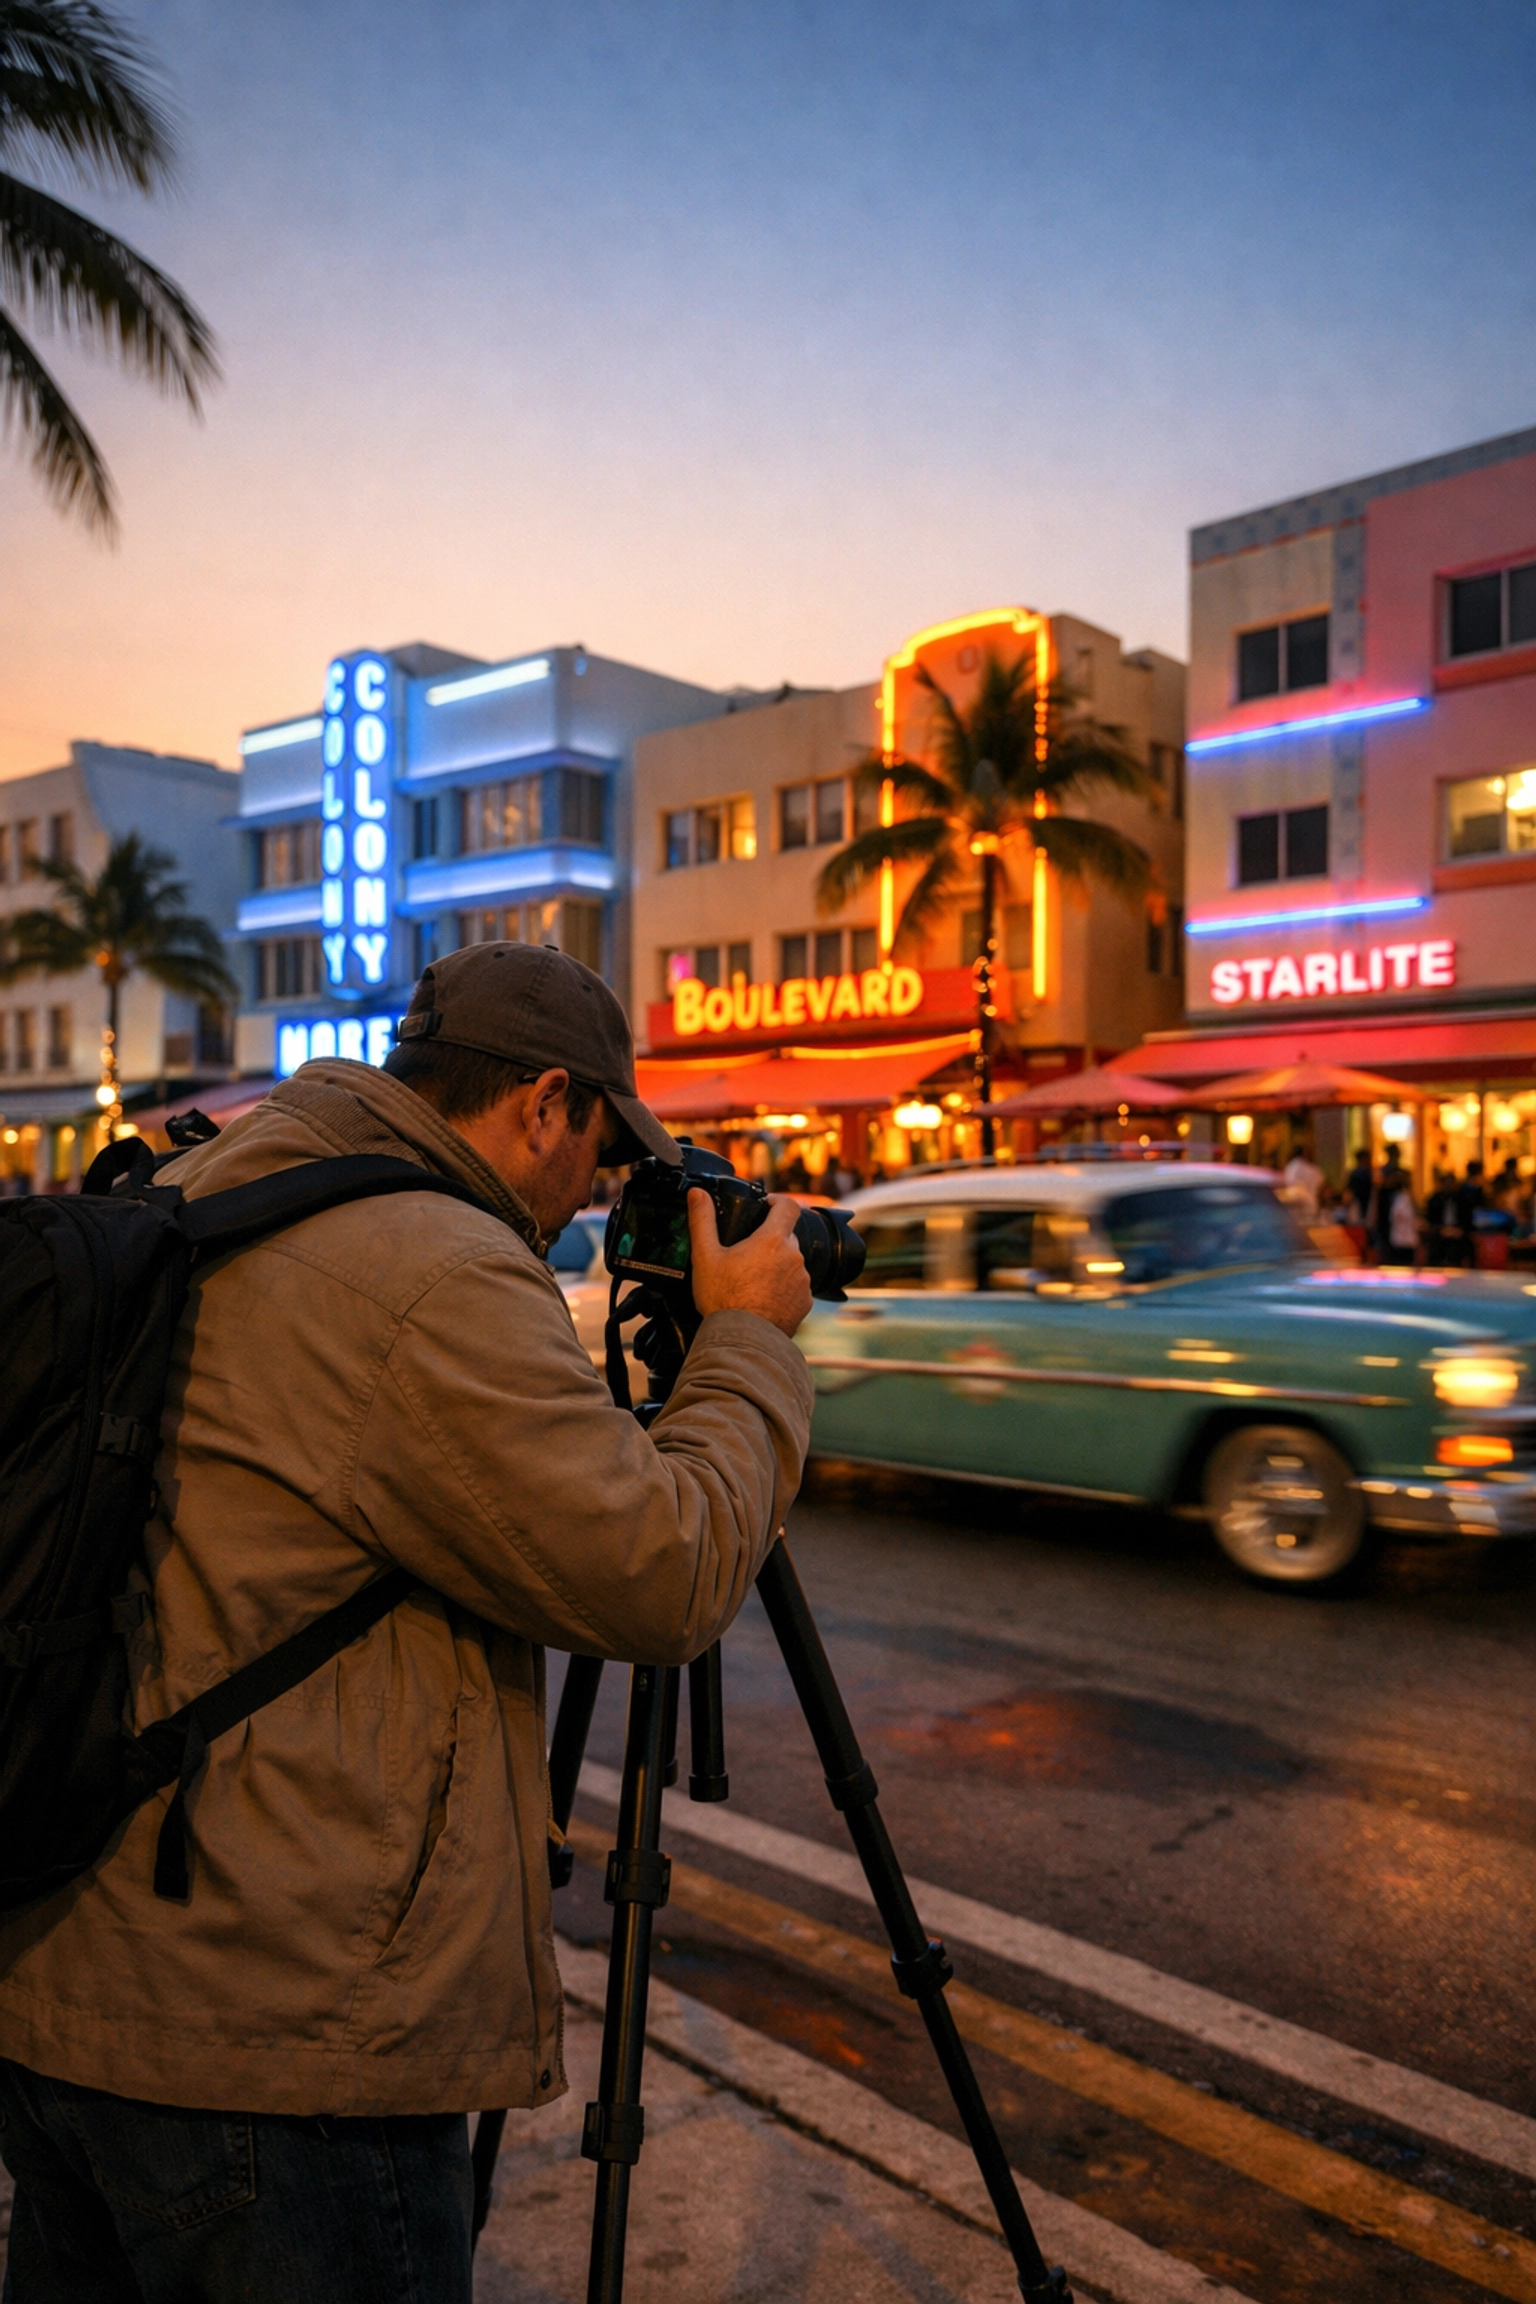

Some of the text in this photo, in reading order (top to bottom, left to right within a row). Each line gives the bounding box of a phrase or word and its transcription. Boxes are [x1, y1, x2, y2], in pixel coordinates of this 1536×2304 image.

[323, 660, 346, 983] COLONY
[352, 660, 387, 983] COLONY
[673, 967, 923, 1035] BOULEVARD
[1211, 940, 1454, 1003] STARLITE
